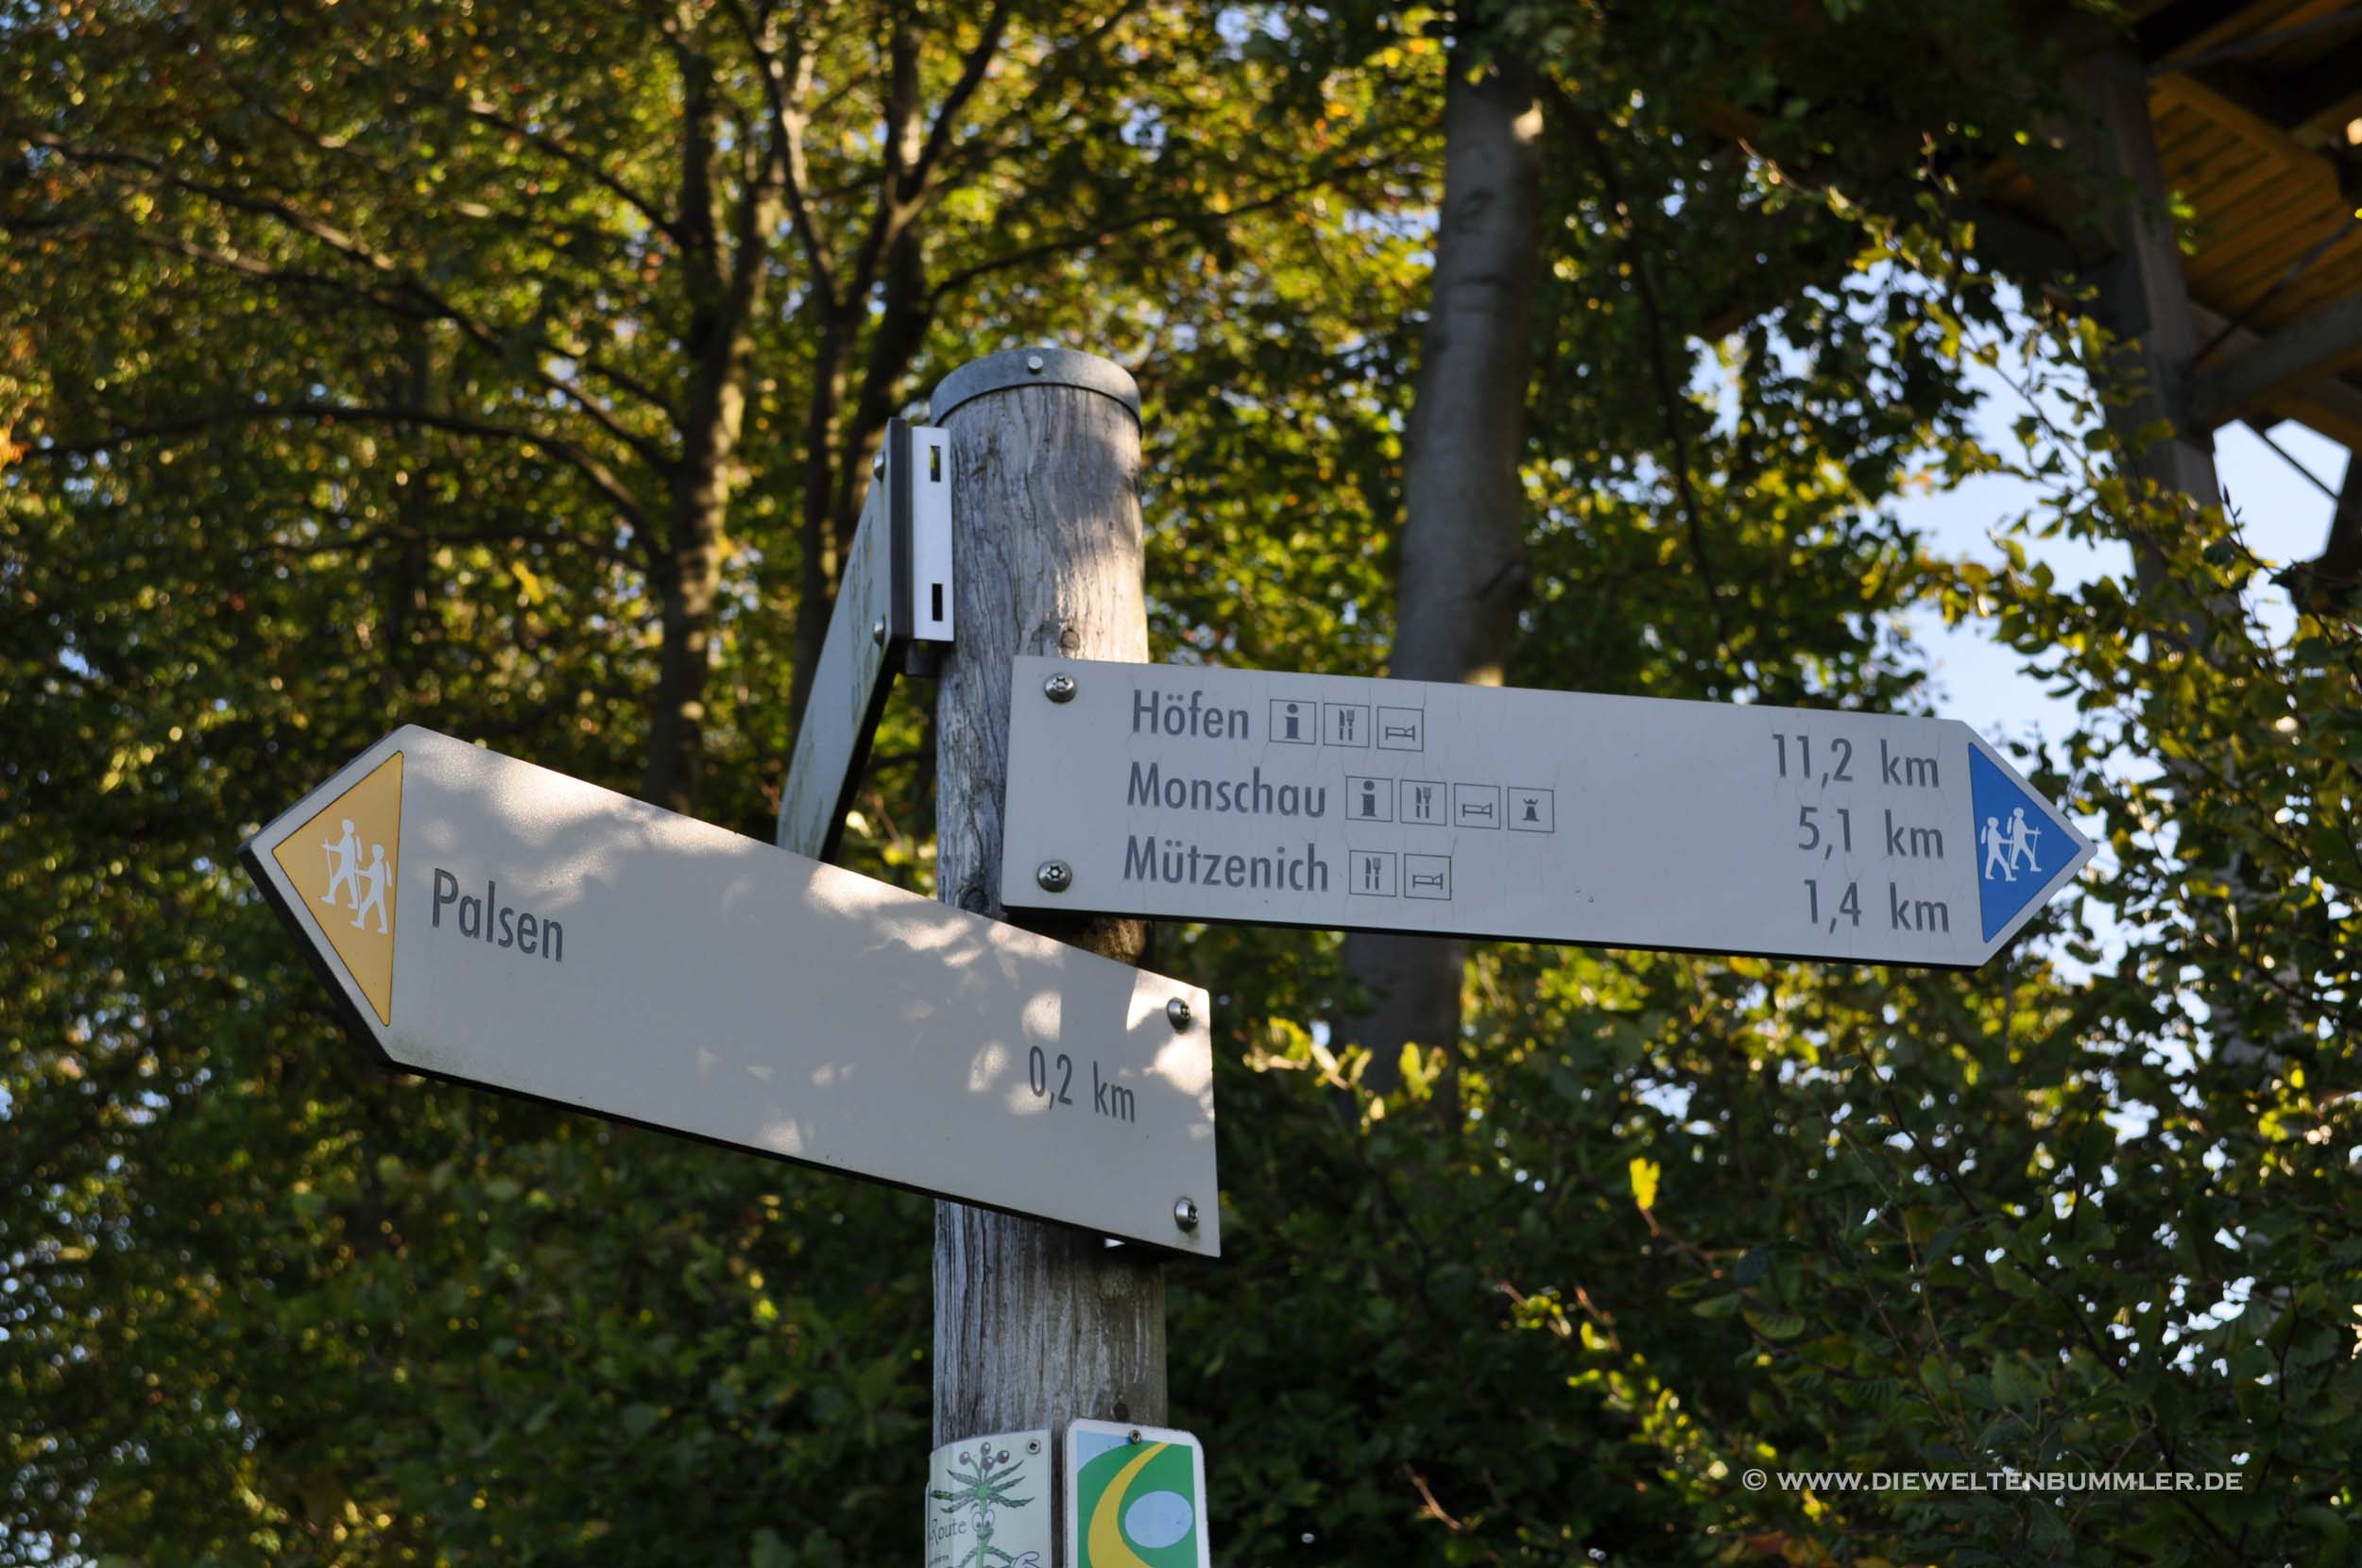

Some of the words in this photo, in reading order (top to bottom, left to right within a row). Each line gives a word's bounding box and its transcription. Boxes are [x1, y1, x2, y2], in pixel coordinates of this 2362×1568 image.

[1133, 690, 1248, 740] Höfen
[1772, 733, 1853, 789] 11,2
[1881, 739, 1939, 788] km
[1126, 761, 1326, 818] Monschau
[1798, 806, 1852, 861] 5,1
[1885, 809, 1943, 859] km
[432, 867, 563, 963] Palsen
[1123, 835, 1328, 892] Mützenich
[1804, 879, 1861, 934] 1,4
[1890, 882, 1949, 933] km
[1029, 1045, 1073, 1110] 0,2
[1092, 1060, 1136, 1123] km
